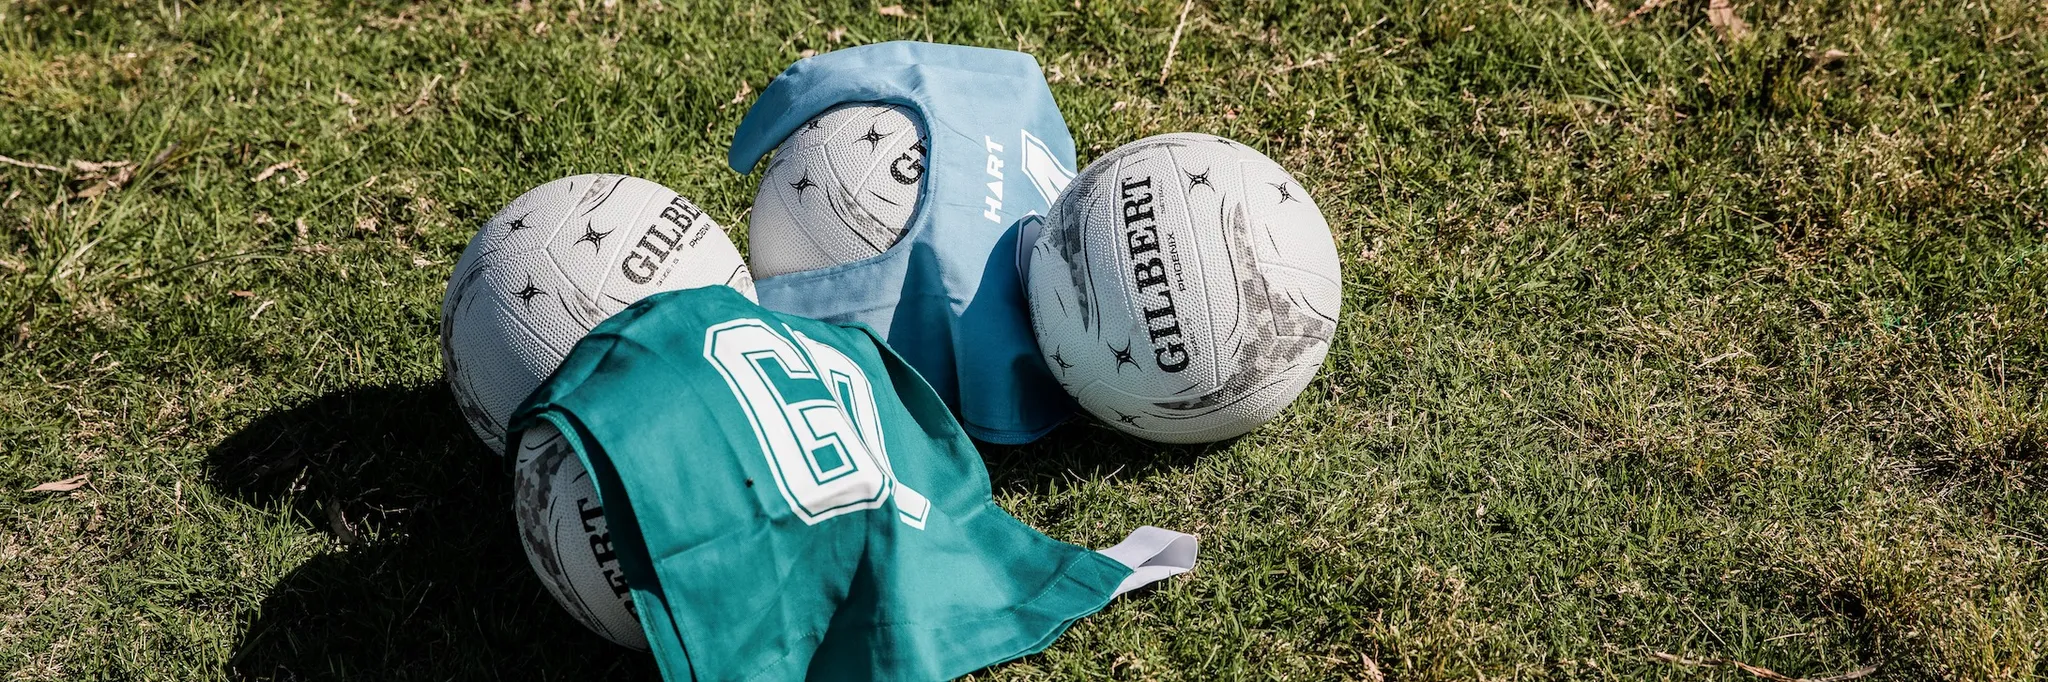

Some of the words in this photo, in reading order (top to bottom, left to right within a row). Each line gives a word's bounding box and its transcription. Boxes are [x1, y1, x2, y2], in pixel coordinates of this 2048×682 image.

[984, 135, 1005, 224] HART
[1121, 175, 1190, 373] GILBERT
[1167, 232, 1187, 291] PHOENIX
